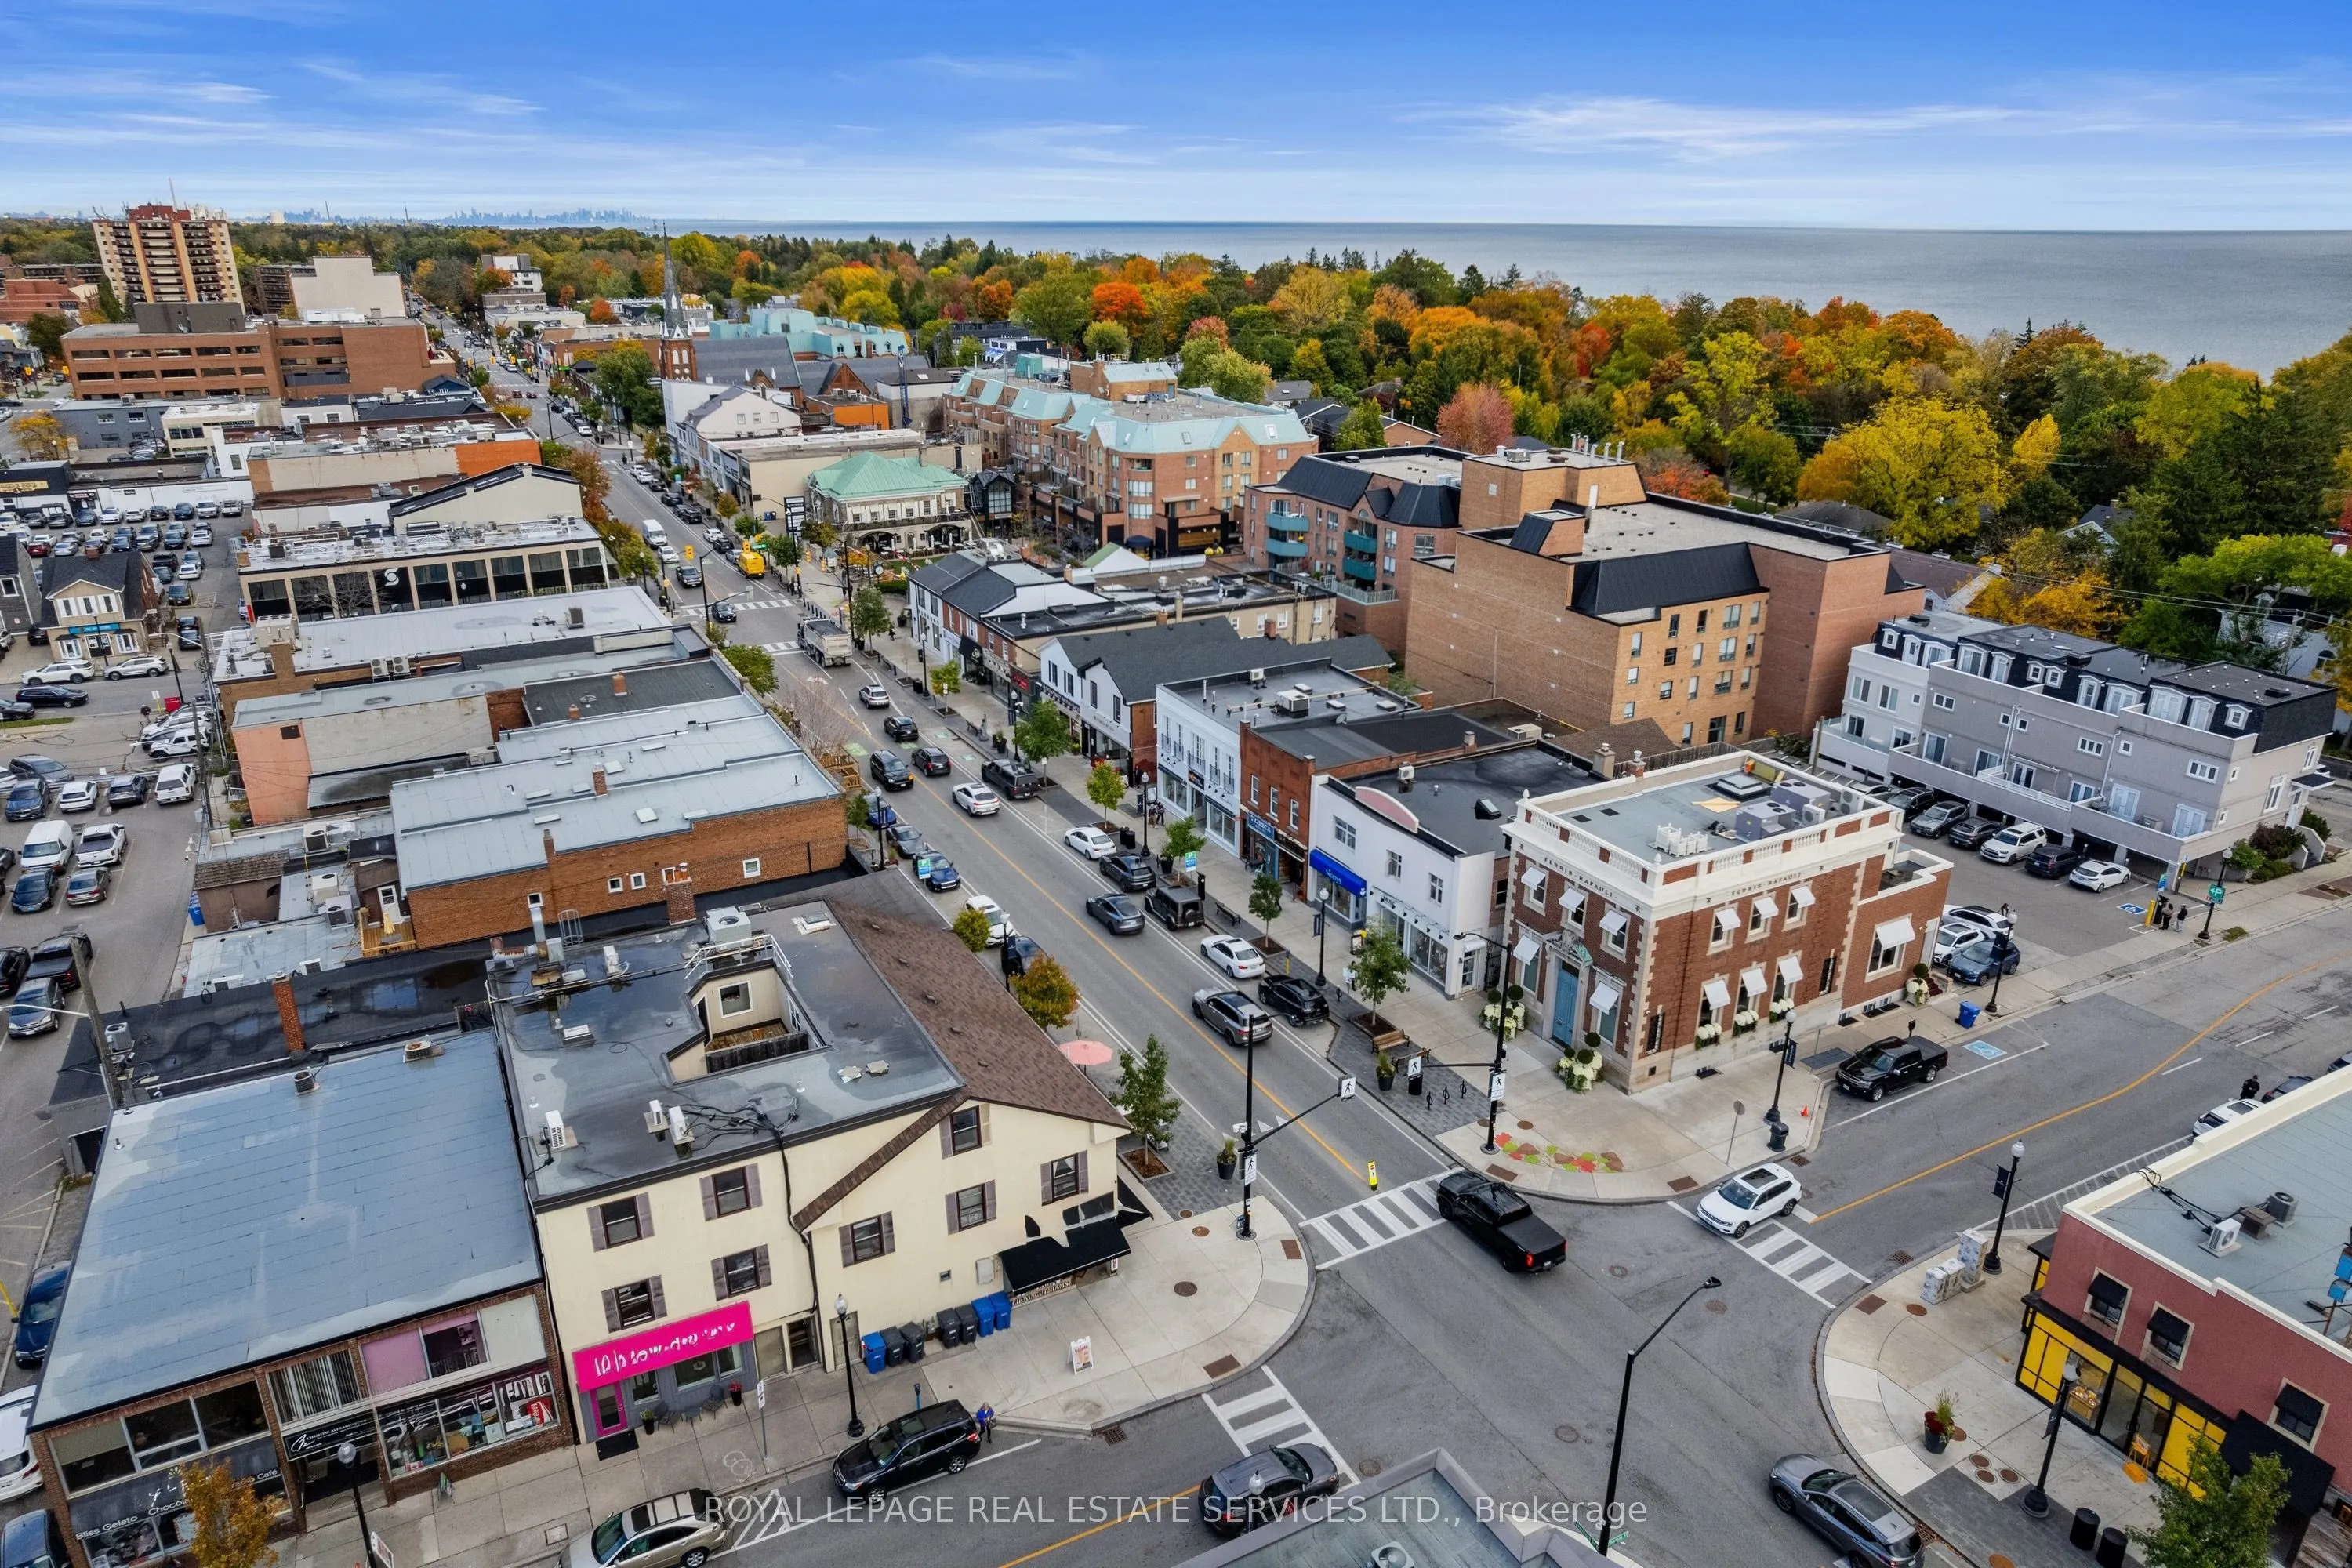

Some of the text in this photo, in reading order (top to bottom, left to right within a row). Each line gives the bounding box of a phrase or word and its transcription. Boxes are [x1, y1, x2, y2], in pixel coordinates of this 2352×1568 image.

[1544, 857, 1573, 876] FERRIS
[1730, 883, 1762, 896] FERRIS
[75, 1528, 100, 1541] Bliss
[102, 1515, 138, 1531] Gelato
[148, 1499, 185, 1515] Chocol
